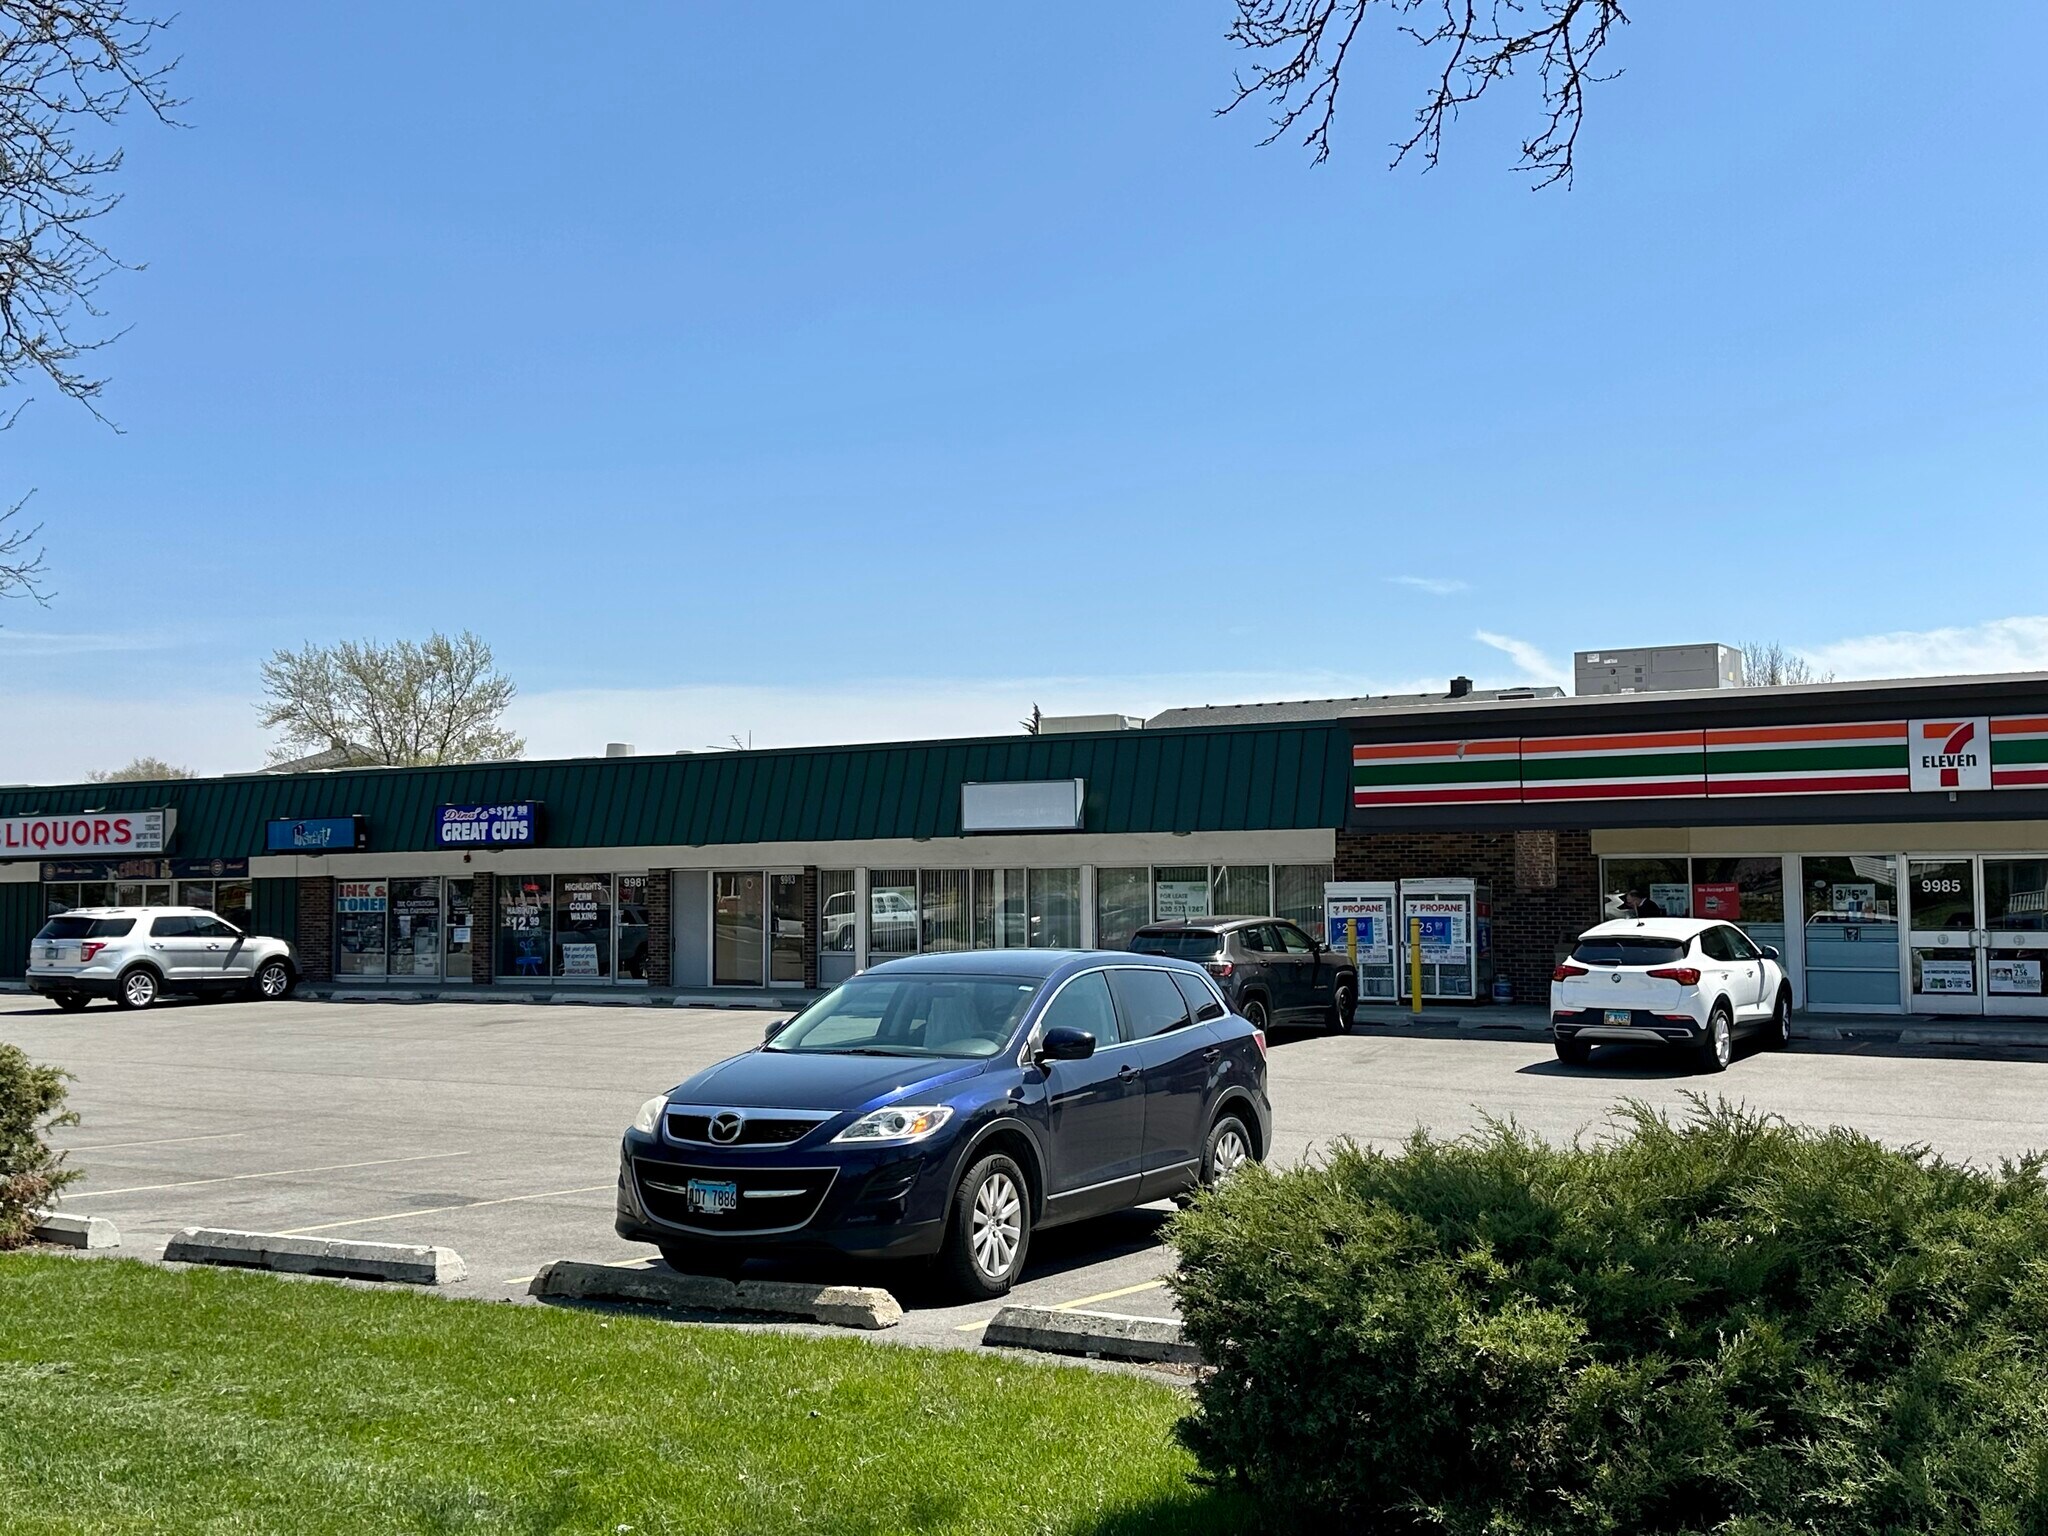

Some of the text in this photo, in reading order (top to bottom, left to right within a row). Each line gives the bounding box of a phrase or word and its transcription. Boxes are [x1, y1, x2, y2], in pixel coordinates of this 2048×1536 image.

[5, 819, 132, 850] LIQUORS
[442, 820, 528, 841] GREAT CUTS
[564, 882, 602, 892] HIGHLIGHTS
[624, 877, 646, 887] 9981
[1921, 879, 1961, 893] 9985
[340, 884, 386, 897] INK &
[573, 892, 592, 901] PERM
[569, 902, 598, 911] COLOR
[1342, 904, 1384, 913] PROPANE
[1420, 904, 1463, 912] PROPANE
[570, 912, 597, 920] WAXING
[712, 1190, 736, 1207] 7886
